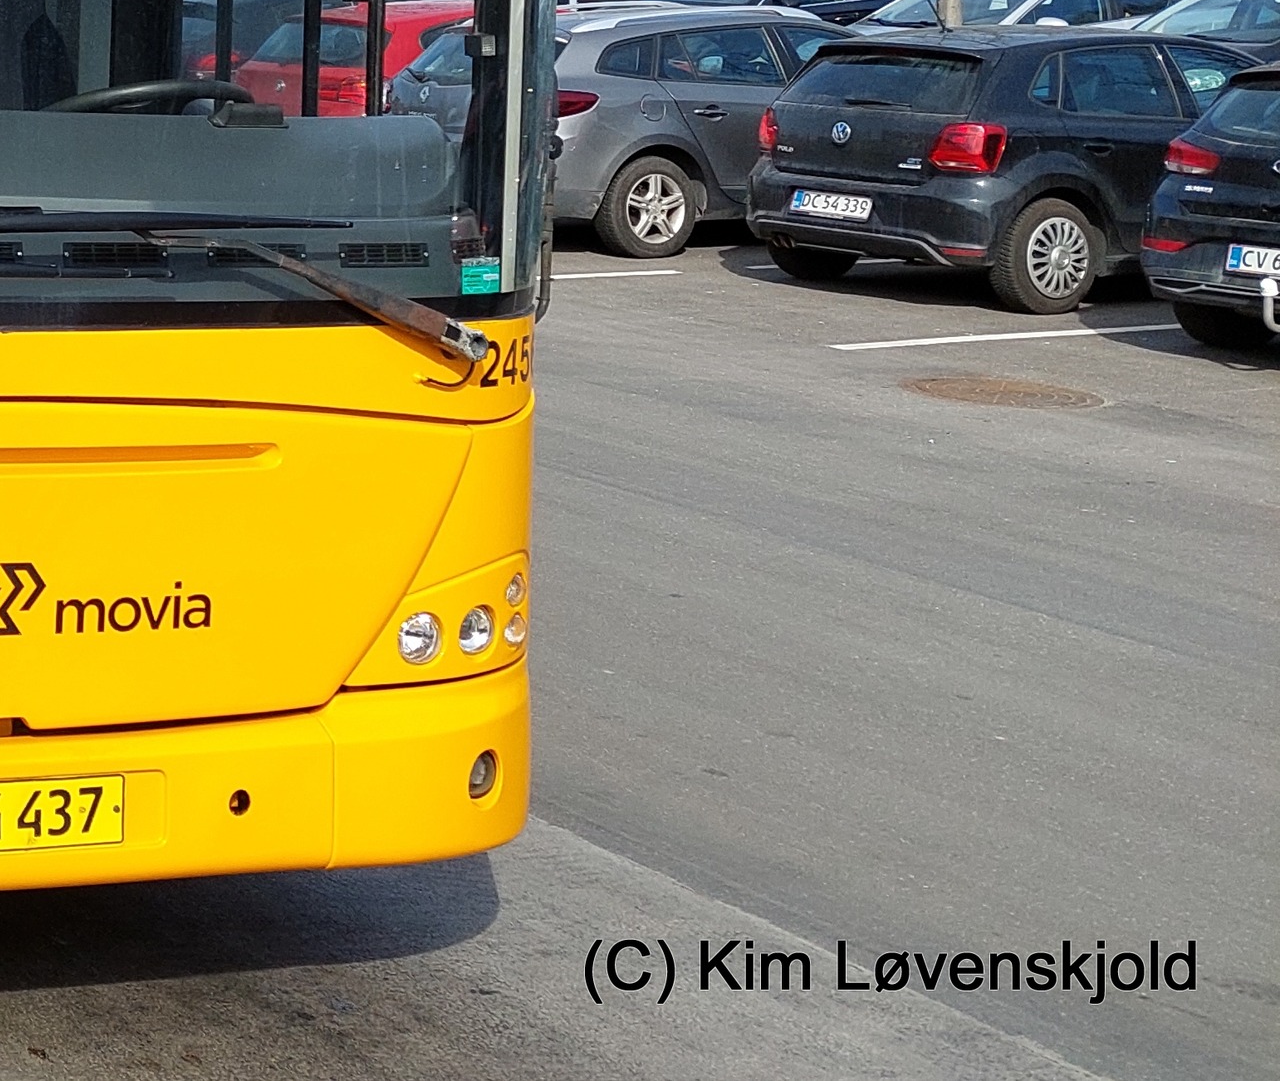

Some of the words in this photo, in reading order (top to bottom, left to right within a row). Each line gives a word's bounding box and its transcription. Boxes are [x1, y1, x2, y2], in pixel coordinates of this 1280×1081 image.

[1242, 250, 1268, 269] CV
[480, 334, 535, 388] 245
[54, 580, 212, 635] movia
[16, 786, 104, 838] 437
